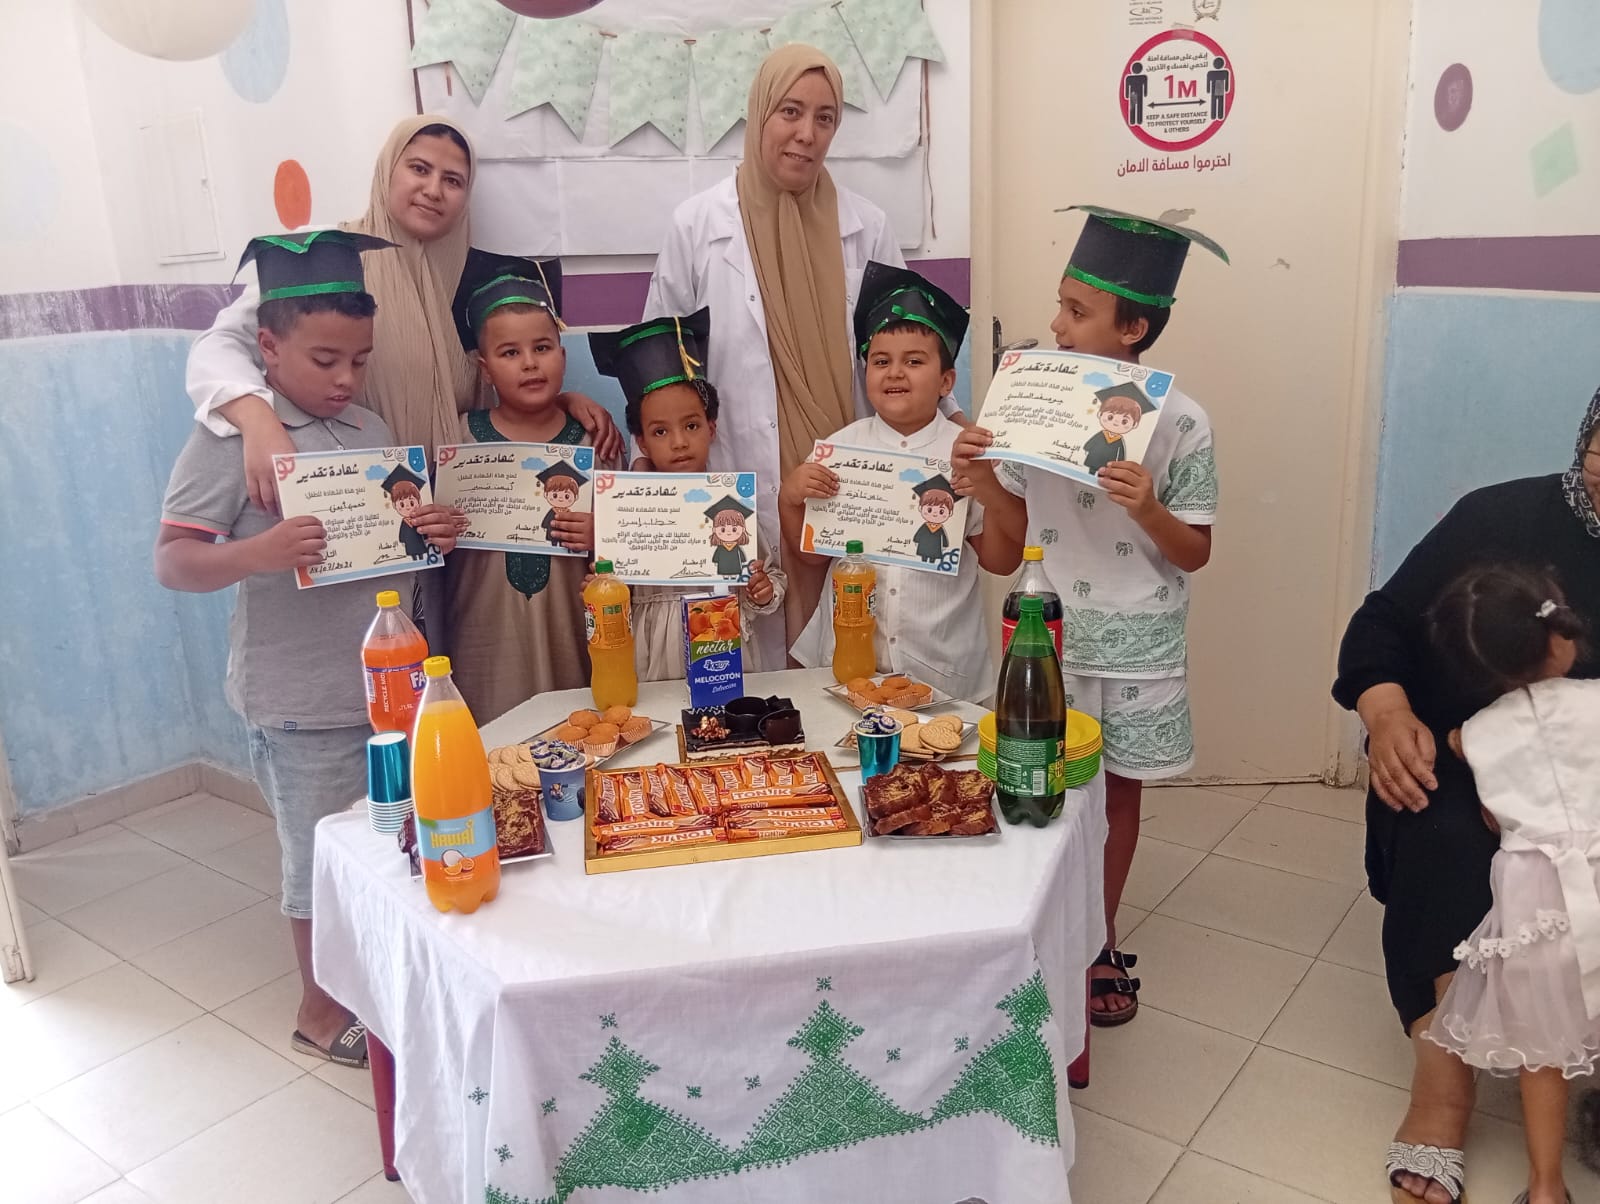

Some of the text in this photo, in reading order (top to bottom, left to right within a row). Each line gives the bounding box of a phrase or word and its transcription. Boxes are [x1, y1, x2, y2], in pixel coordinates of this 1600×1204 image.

[1164, 74, 1197, 99] 1M
[1151, 156, 1190, 172] مسافة
[1193, 153, 1231, 173] احترموا
[1009, 361, 1079, 375] شهادة تقدير
[452, 453, 516, 469] شهادة تقدير
[829, 458, 895, 473] شهادة تقدير
[296, 463, 359, 484] شهادة تقدير
[611, 485, 678, 499] شهادة تقدير
[694, 671, 741, 684] MELOCOTÓN
[732, 787, 792, 800] TONIK
[613, 820, 675, 833] TONIK
